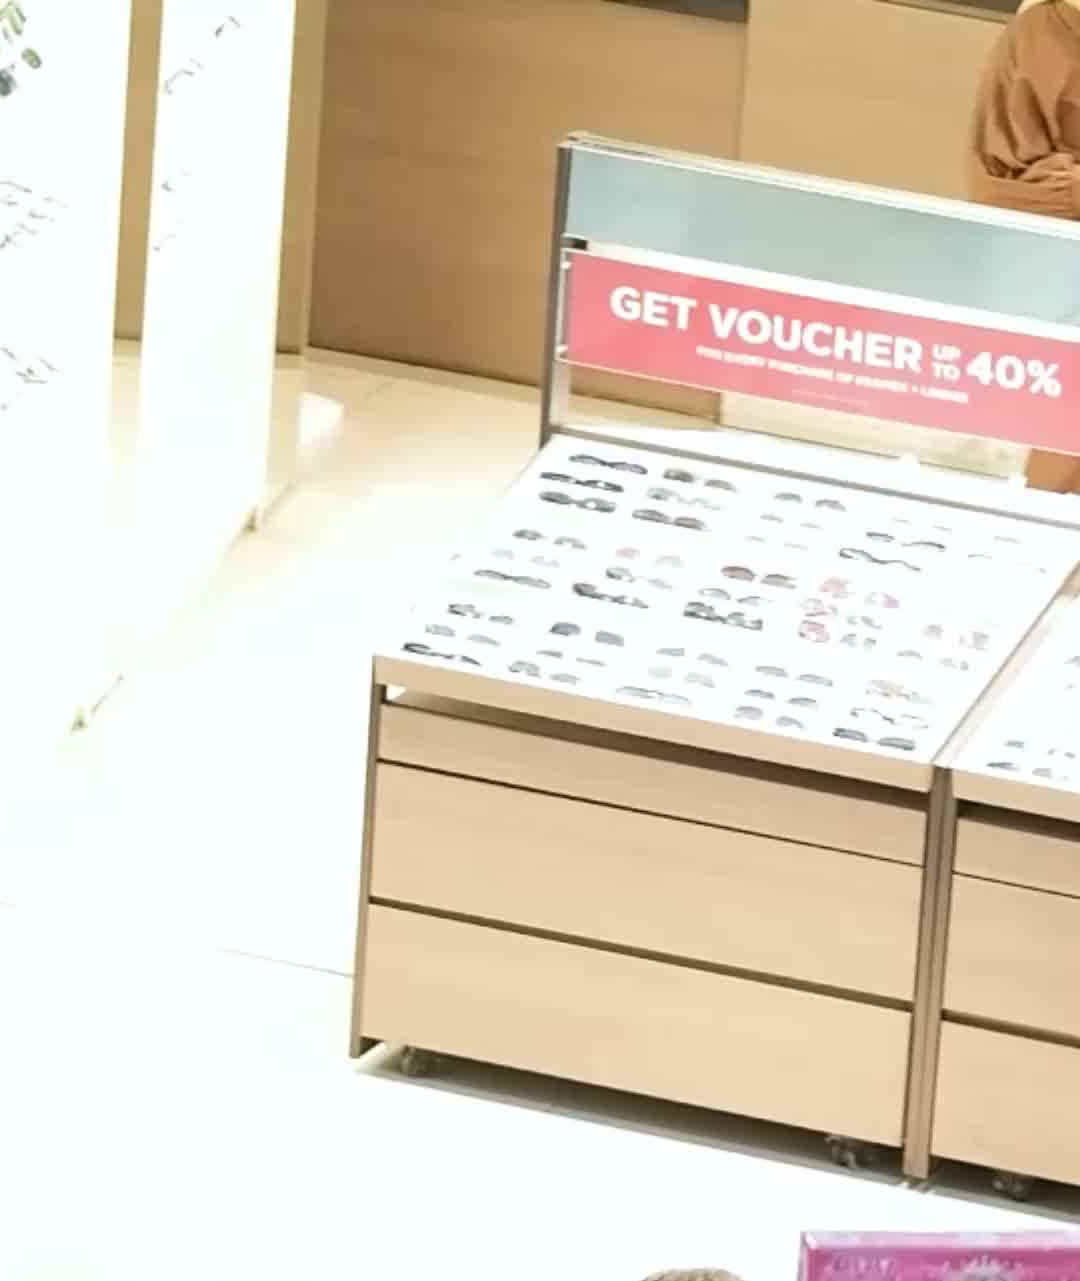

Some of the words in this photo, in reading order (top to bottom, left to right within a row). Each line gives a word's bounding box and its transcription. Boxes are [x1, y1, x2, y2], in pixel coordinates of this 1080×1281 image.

[609, 285, 697, 331] GET
[707, 302, 922, 372] VOUCHER
[932, 343, 962, 362] UP
[932, 362, 961, 381] TO
[966, 351, 1062, 397] 40%
